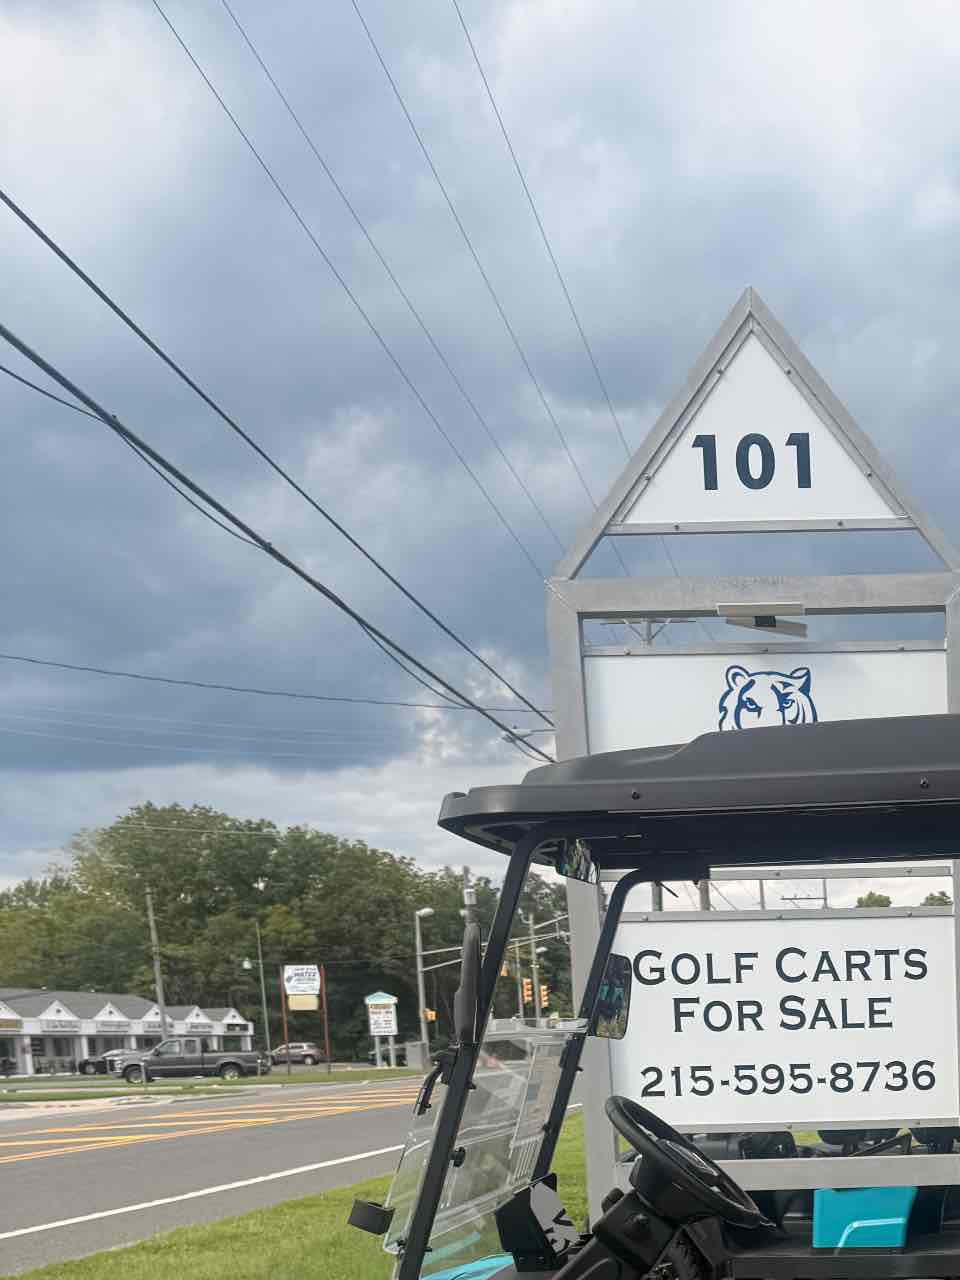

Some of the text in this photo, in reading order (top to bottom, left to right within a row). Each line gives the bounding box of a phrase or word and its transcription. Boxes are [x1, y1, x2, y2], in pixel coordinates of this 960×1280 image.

[691, 431, 812, 491] 101
[632, 946, 928, 986] GOLF CARTS
[672, 994, 894, 1033] FOR SALE
[640, 1059, 937, 1098] 215-595-8736
